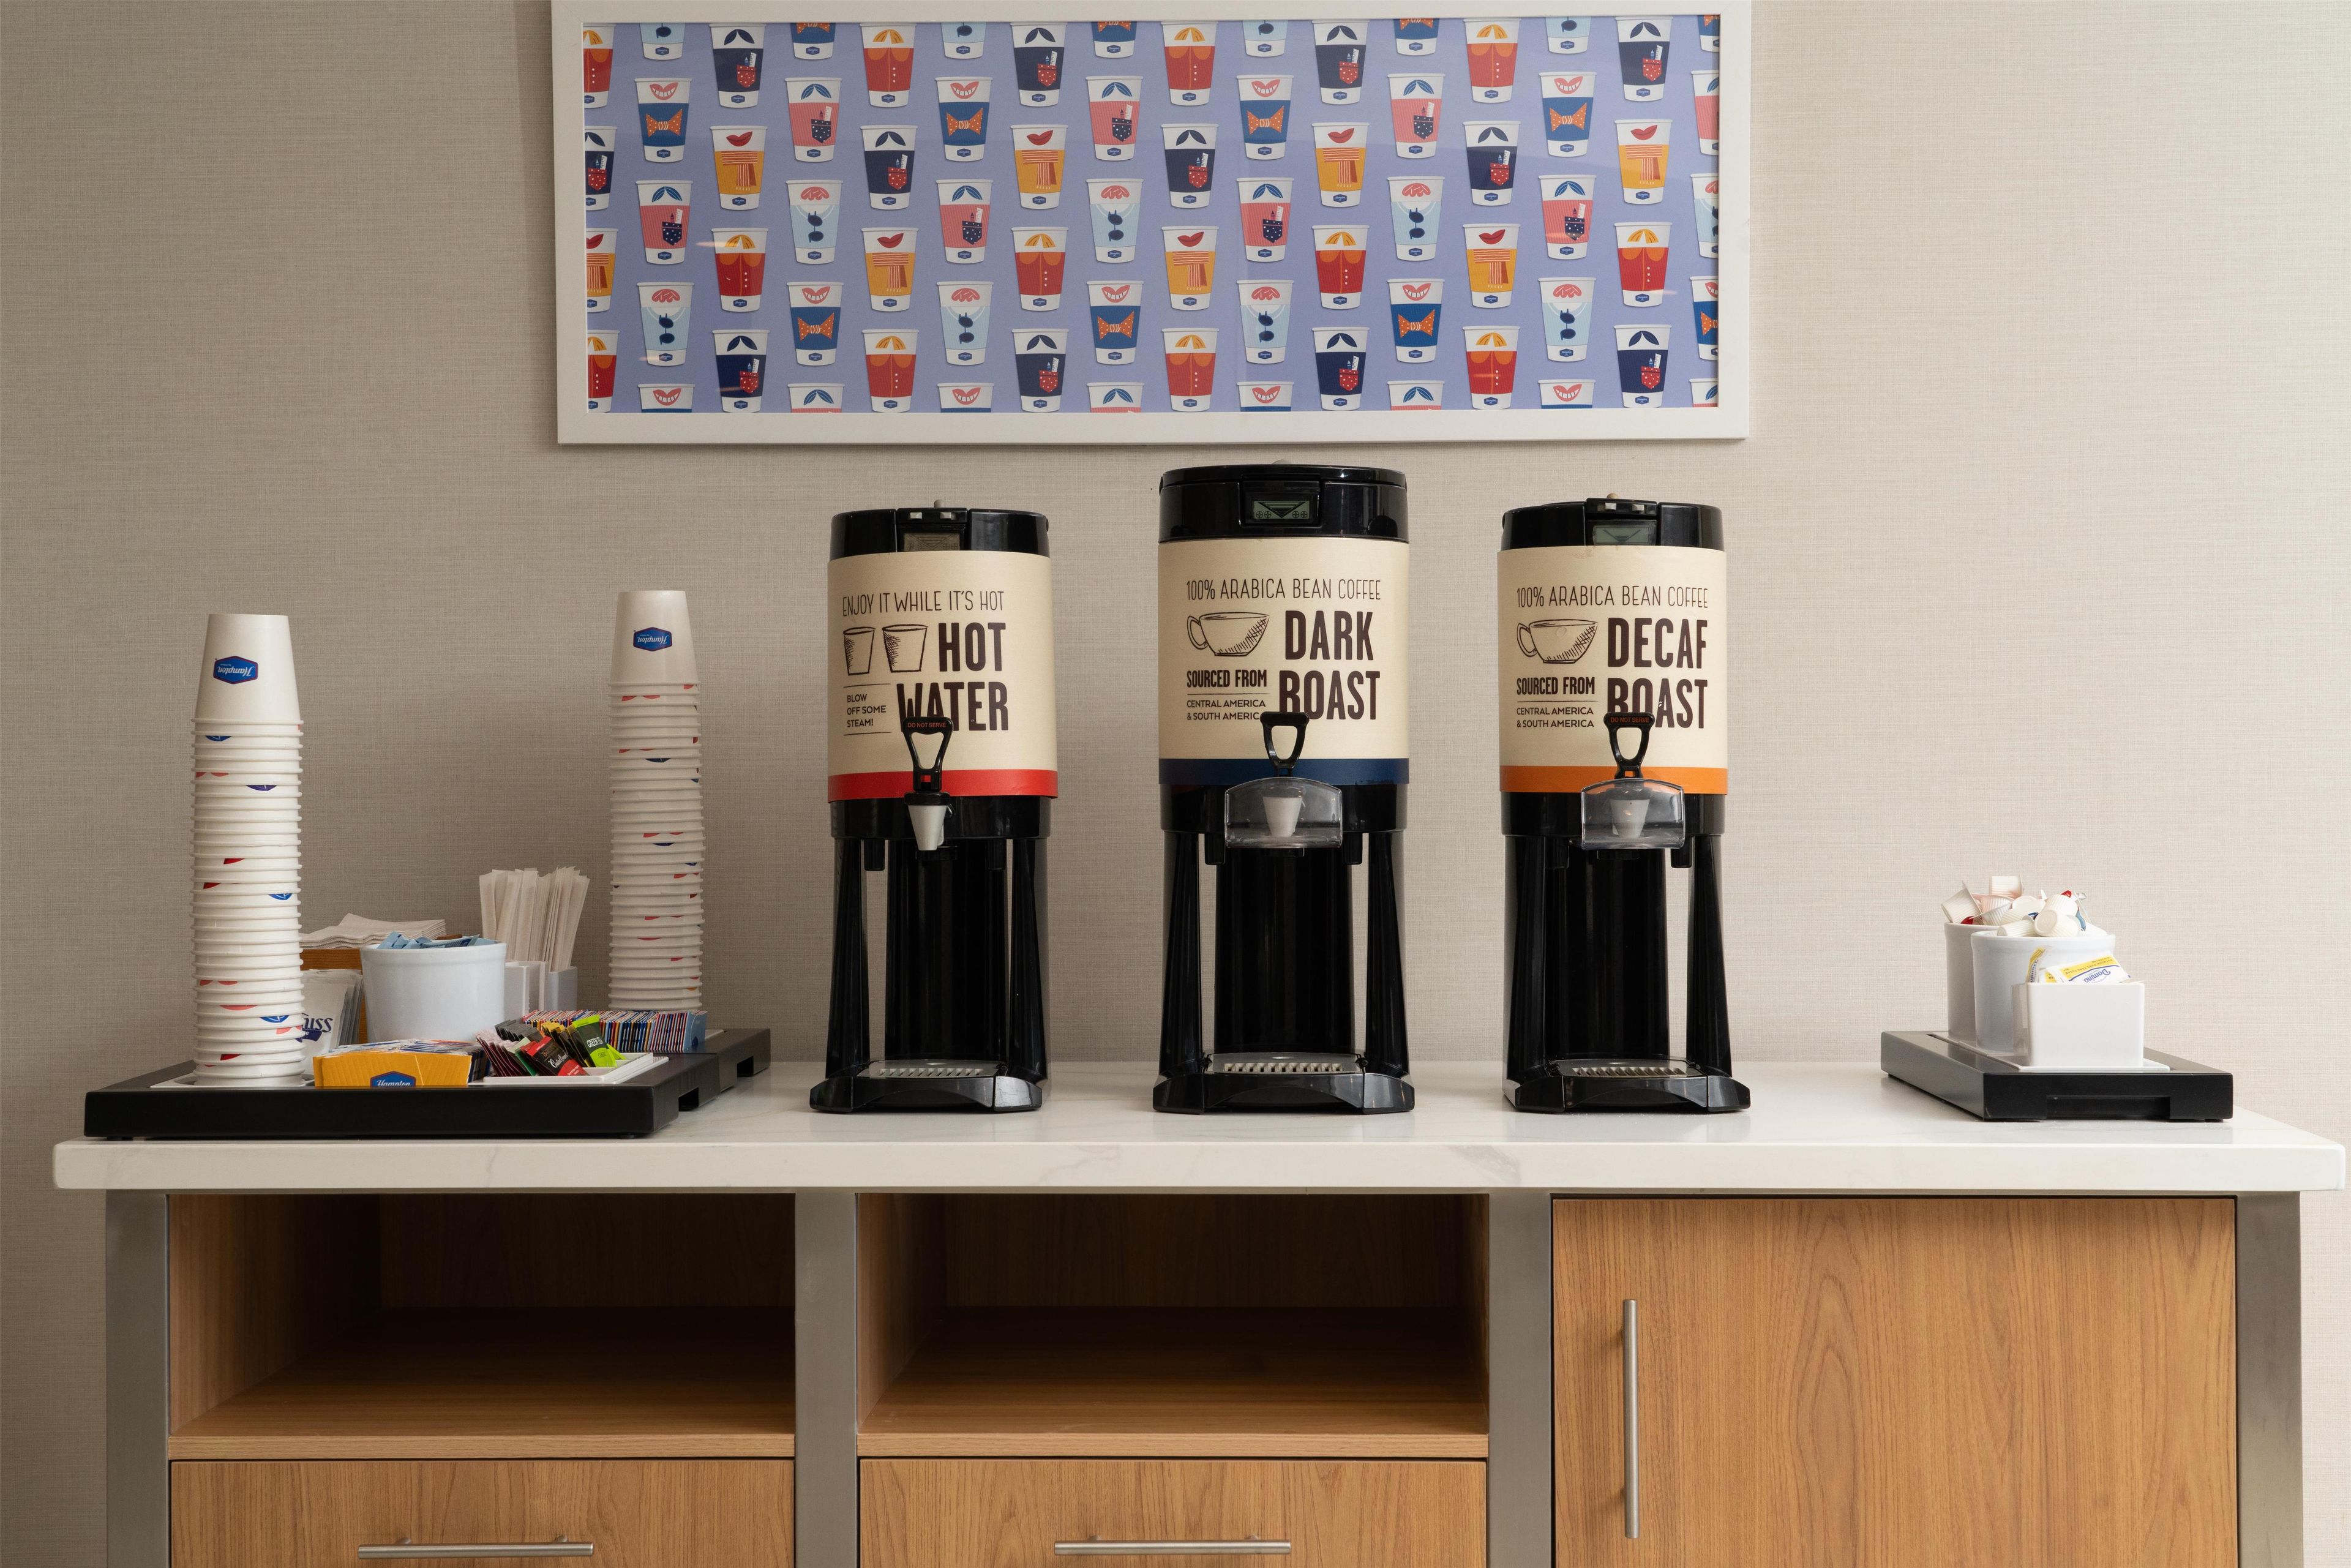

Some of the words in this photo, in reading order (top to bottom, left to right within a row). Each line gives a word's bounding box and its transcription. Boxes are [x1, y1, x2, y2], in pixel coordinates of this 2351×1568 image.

[1187, 579, 1215, 601] 100%
[1220, 579, 1285, 599] ARABICA
[1293, 579, 1331, 598] BEAN
[1339, 579, 1381, 600] COFFEE
[1517, 587, 1544, 607] 100%
[1549, 585, 1614, 606] ARABICA
[1622, 585, 1660, 606] BEAN
[1668, 587, 1708, 608] COFFEE
[843, 594, 874, 617] ENJOY
[880, 593, 890, 613] IT
[894, 591, 942, 612] WHILE
[950, 591, 973, 610] IT'S
[980, 591, 1004, 610] HOT
[637, 636, 669, 645] Hampton
[1285, 610, 1373, 661] DARK
[1608, 618, 1708, 669] DECAF
[939, 622, 1006, 672] HOT
[217, 666, 255, 677] Hampton
[1187, 670, 1230, 688] SOURCED
[1235, 669, 1267, 687] FROM
[1279, 670, 1380, 719] ROAST
[1517, 677, 1558, 695] SOURCED
[1563, 677, 1595, 694] FROM
[847, 694, 867, 703] BLOW
[896, 681, 1008, 732] WATER
[1607, 678, 1708, 729] ROAST
[847, 707, 860, 715] OFF
[862, 705, 886, 714] SOME
[1187, 712, 1192, 721] &
[847, 718, 873, 727] STEAM!
[2083, 969, 2111, 983] Domino
